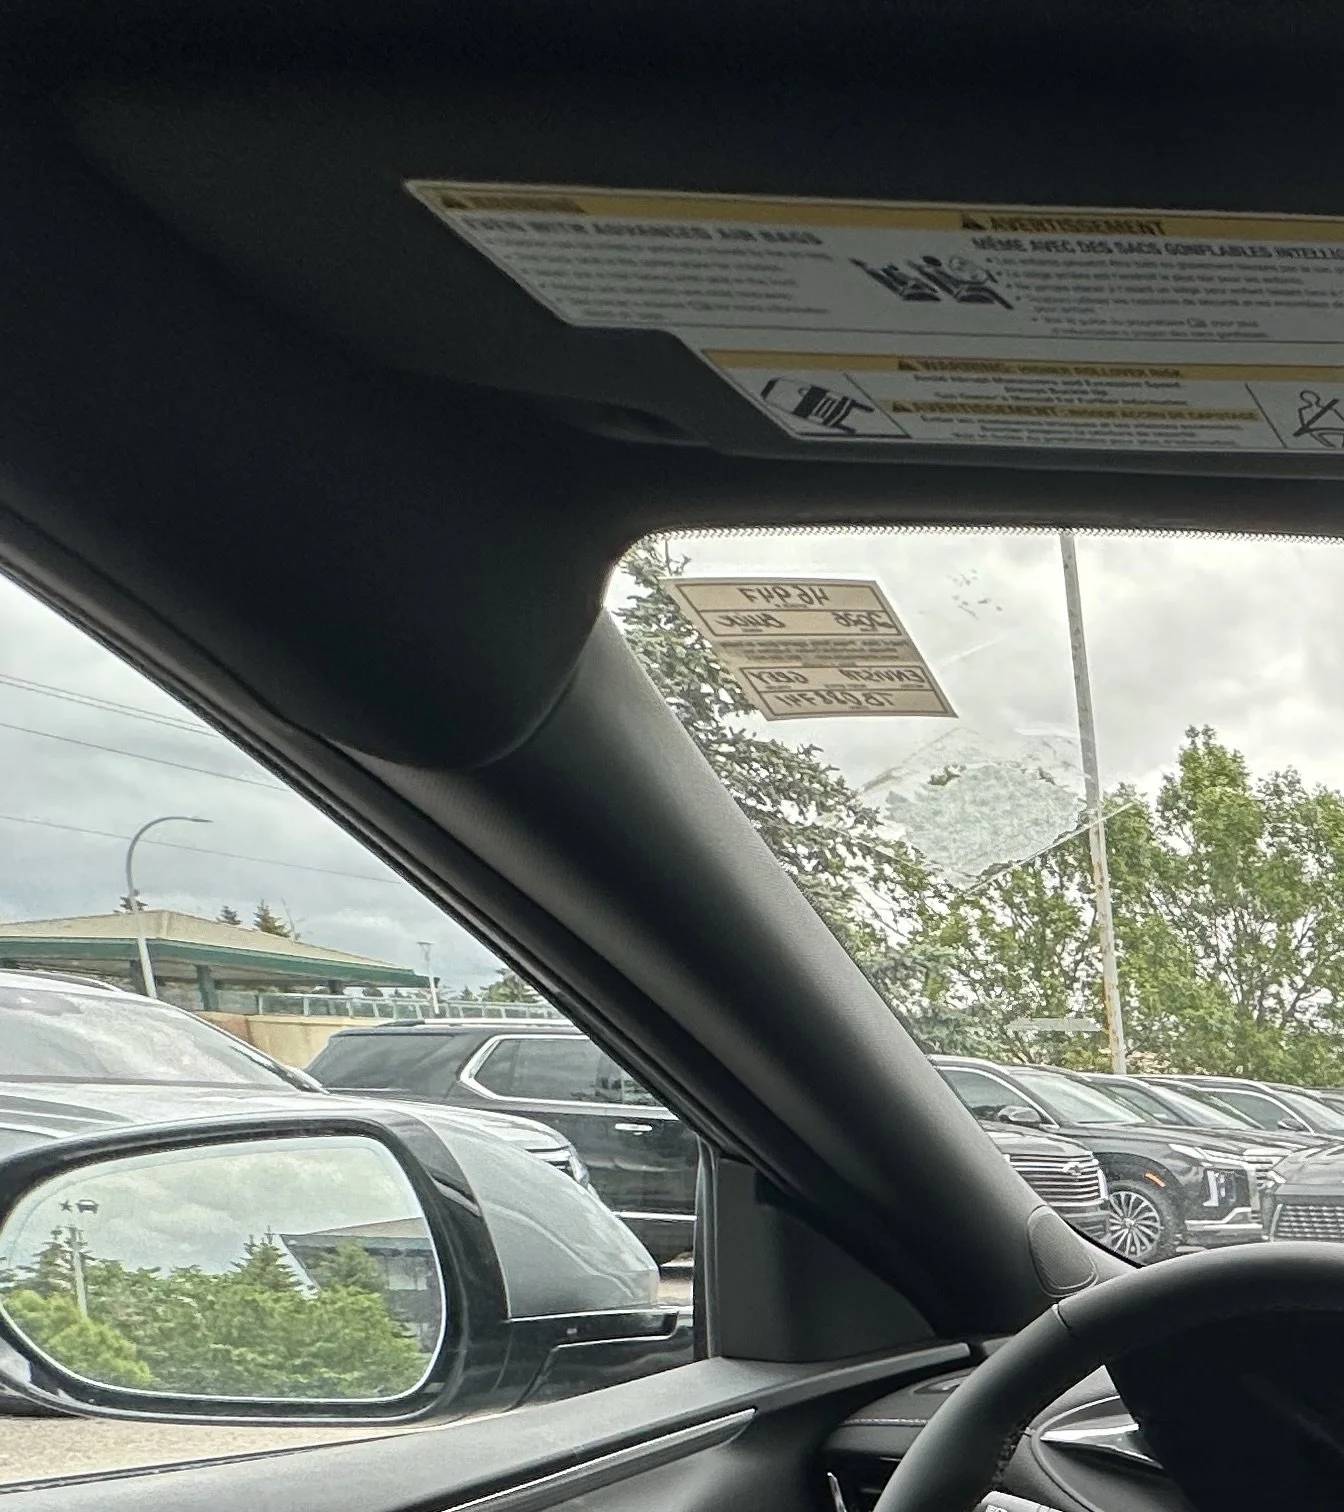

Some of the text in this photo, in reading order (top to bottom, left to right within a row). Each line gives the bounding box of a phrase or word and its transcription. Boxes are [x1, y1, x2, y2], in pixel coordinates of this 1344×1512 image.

[989, 216, 1166, 236] AVERTISSEMENT
[971, 236, 1028, 252] MÊME
[1030, 239, 1077, 253] AVEC
[1077, 240, 1113, 254] DES
[1114, 241, 1162, 255] SACS
